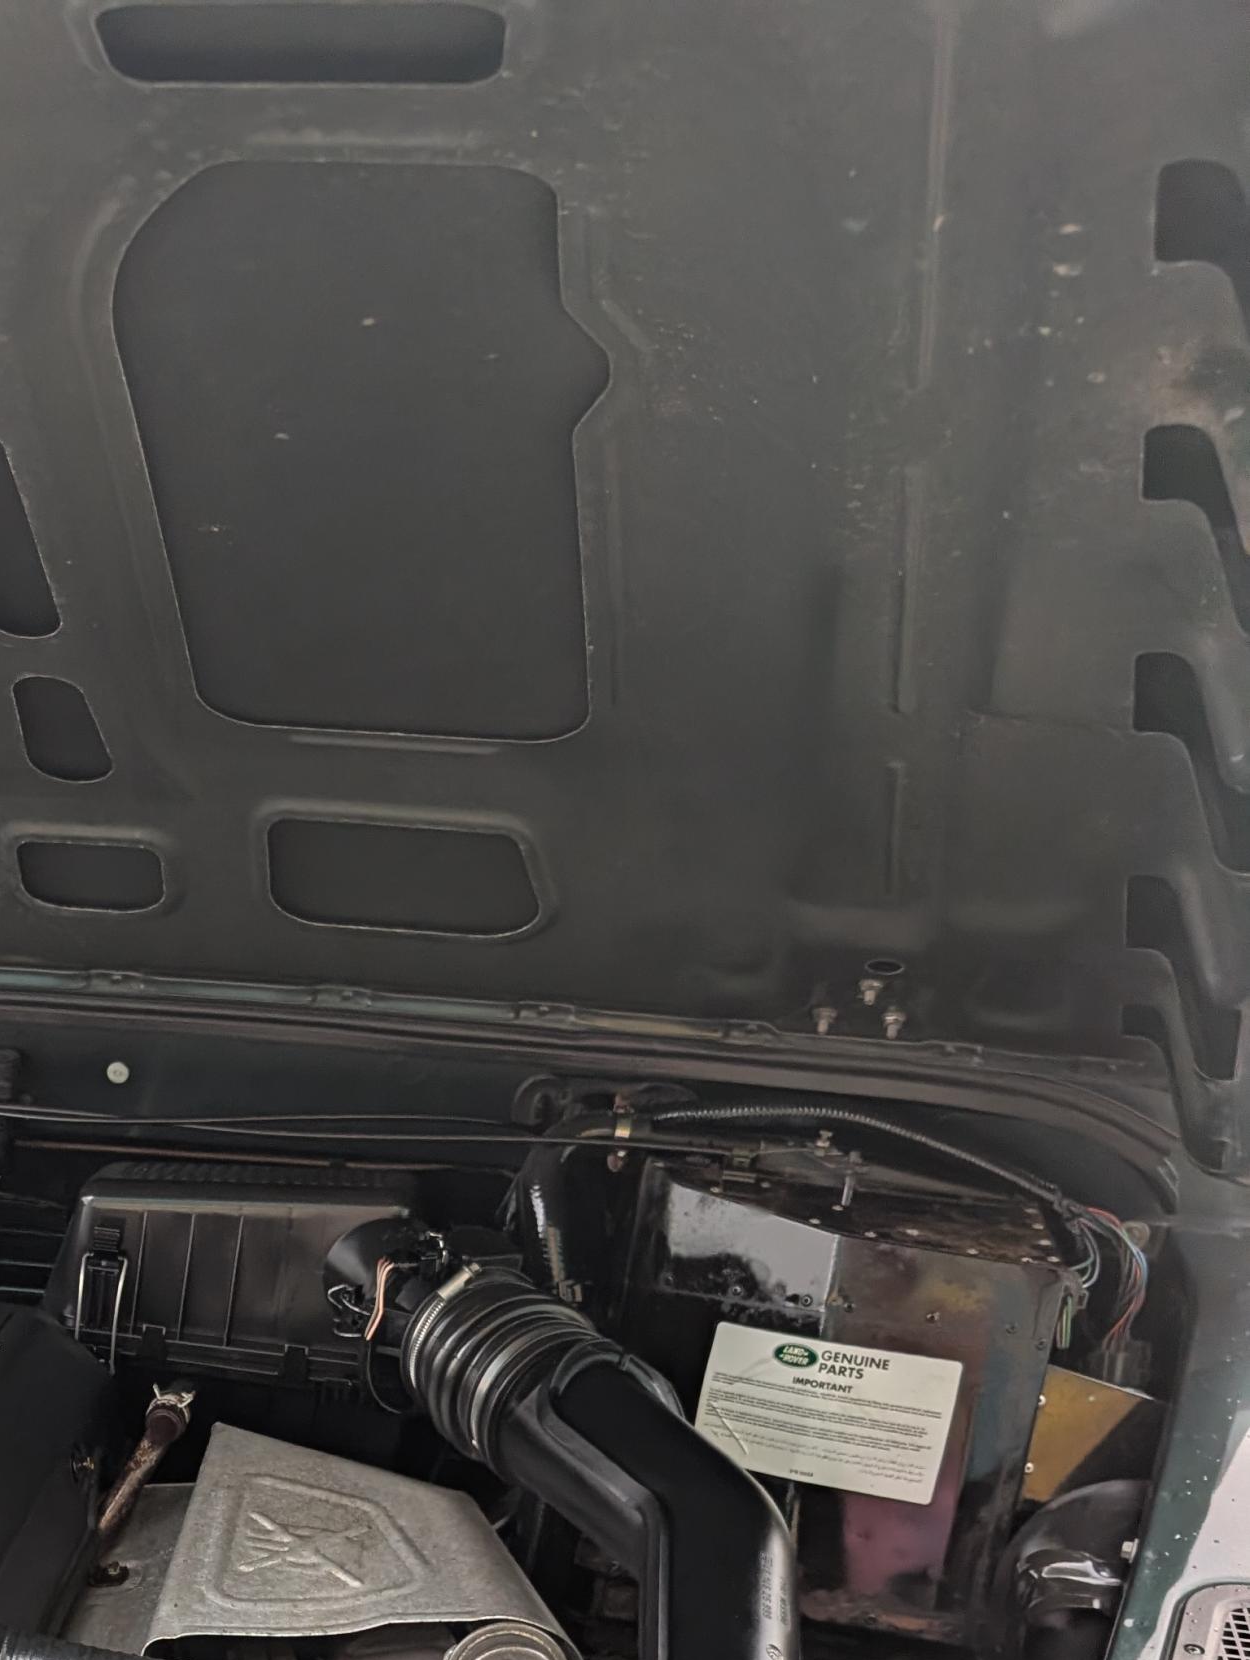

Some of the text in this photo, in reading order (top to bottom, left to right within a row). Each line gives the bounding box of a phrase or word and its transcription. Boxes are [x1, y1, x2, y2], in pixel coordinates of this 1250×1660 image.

[821, 1350, 890, 1371] GENUINE
[818, 1362, 864, 1380] PARTS
[792, 1376, 854, 1394] IMPORTANT
